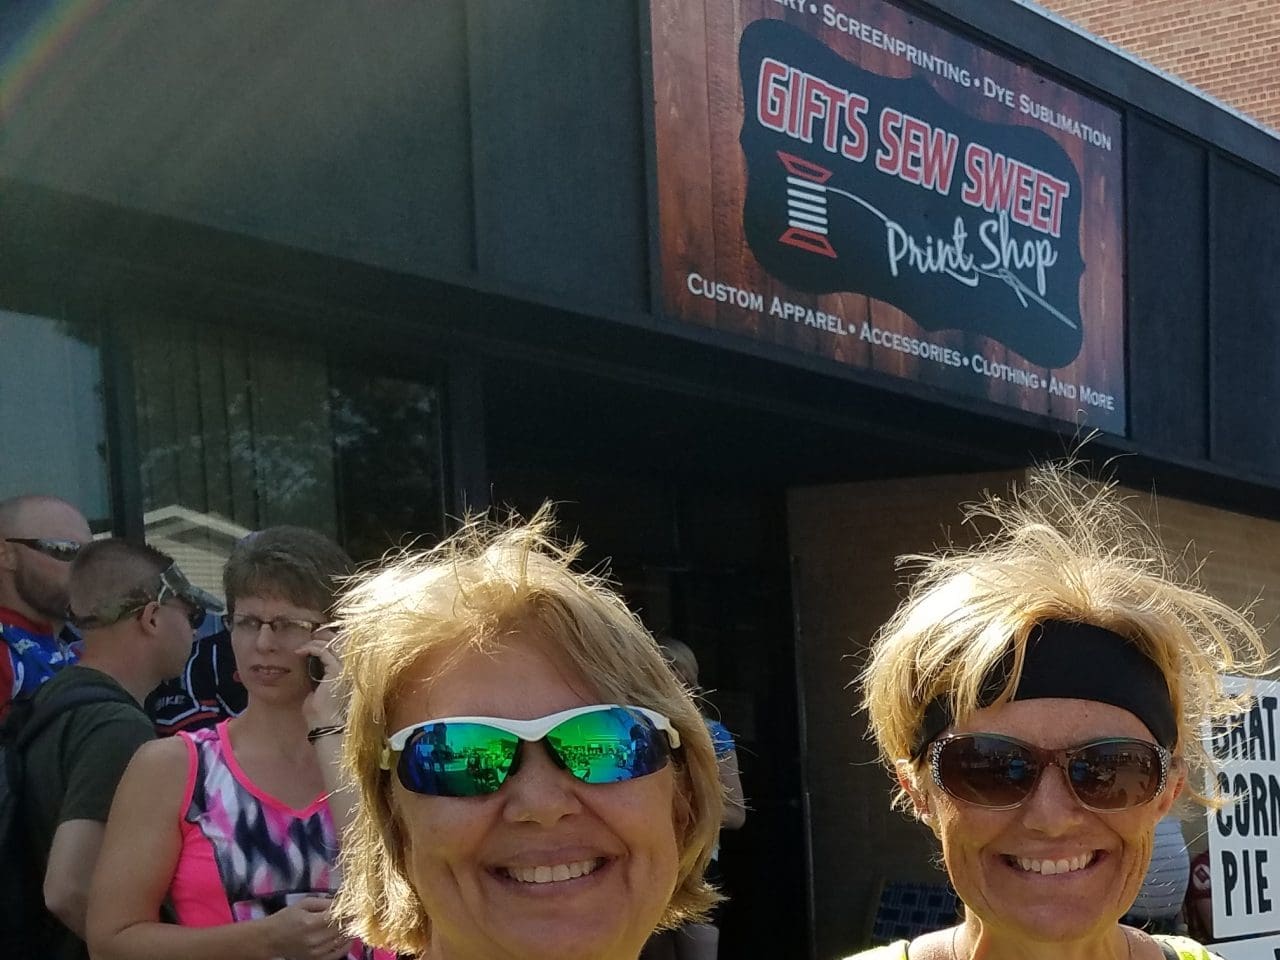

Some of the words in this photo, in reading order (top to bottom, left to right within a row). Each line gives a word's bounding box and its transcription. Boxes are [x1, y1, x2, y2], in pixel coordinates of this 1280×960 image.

[823, 4, 971, 88] SCREENPRINTING
[984, 77, 1015, 108] DYE
[1019, 94, 1112, 151] SUBLIMATION
[757, 57, 869, 162] GIFTS
[876, 107, 959, 195] SEW
[961, 142, 1070, 238] SWEET
[886, 216, 976, 284] Print
[979, 210, 1057, 296] Shop
[687, 273, 763, 312] CUSTOM
[769, 297, 848, 335] APPAREL
[860, 323, 962, 367] ACCESSORIES
[972, 355, 1039, 389] CLOTHING
[1049, 377, 1077, 399] AND
[1080, 385, 1115, 410] MORE
[1221, 850, 1272, 916] PIE
